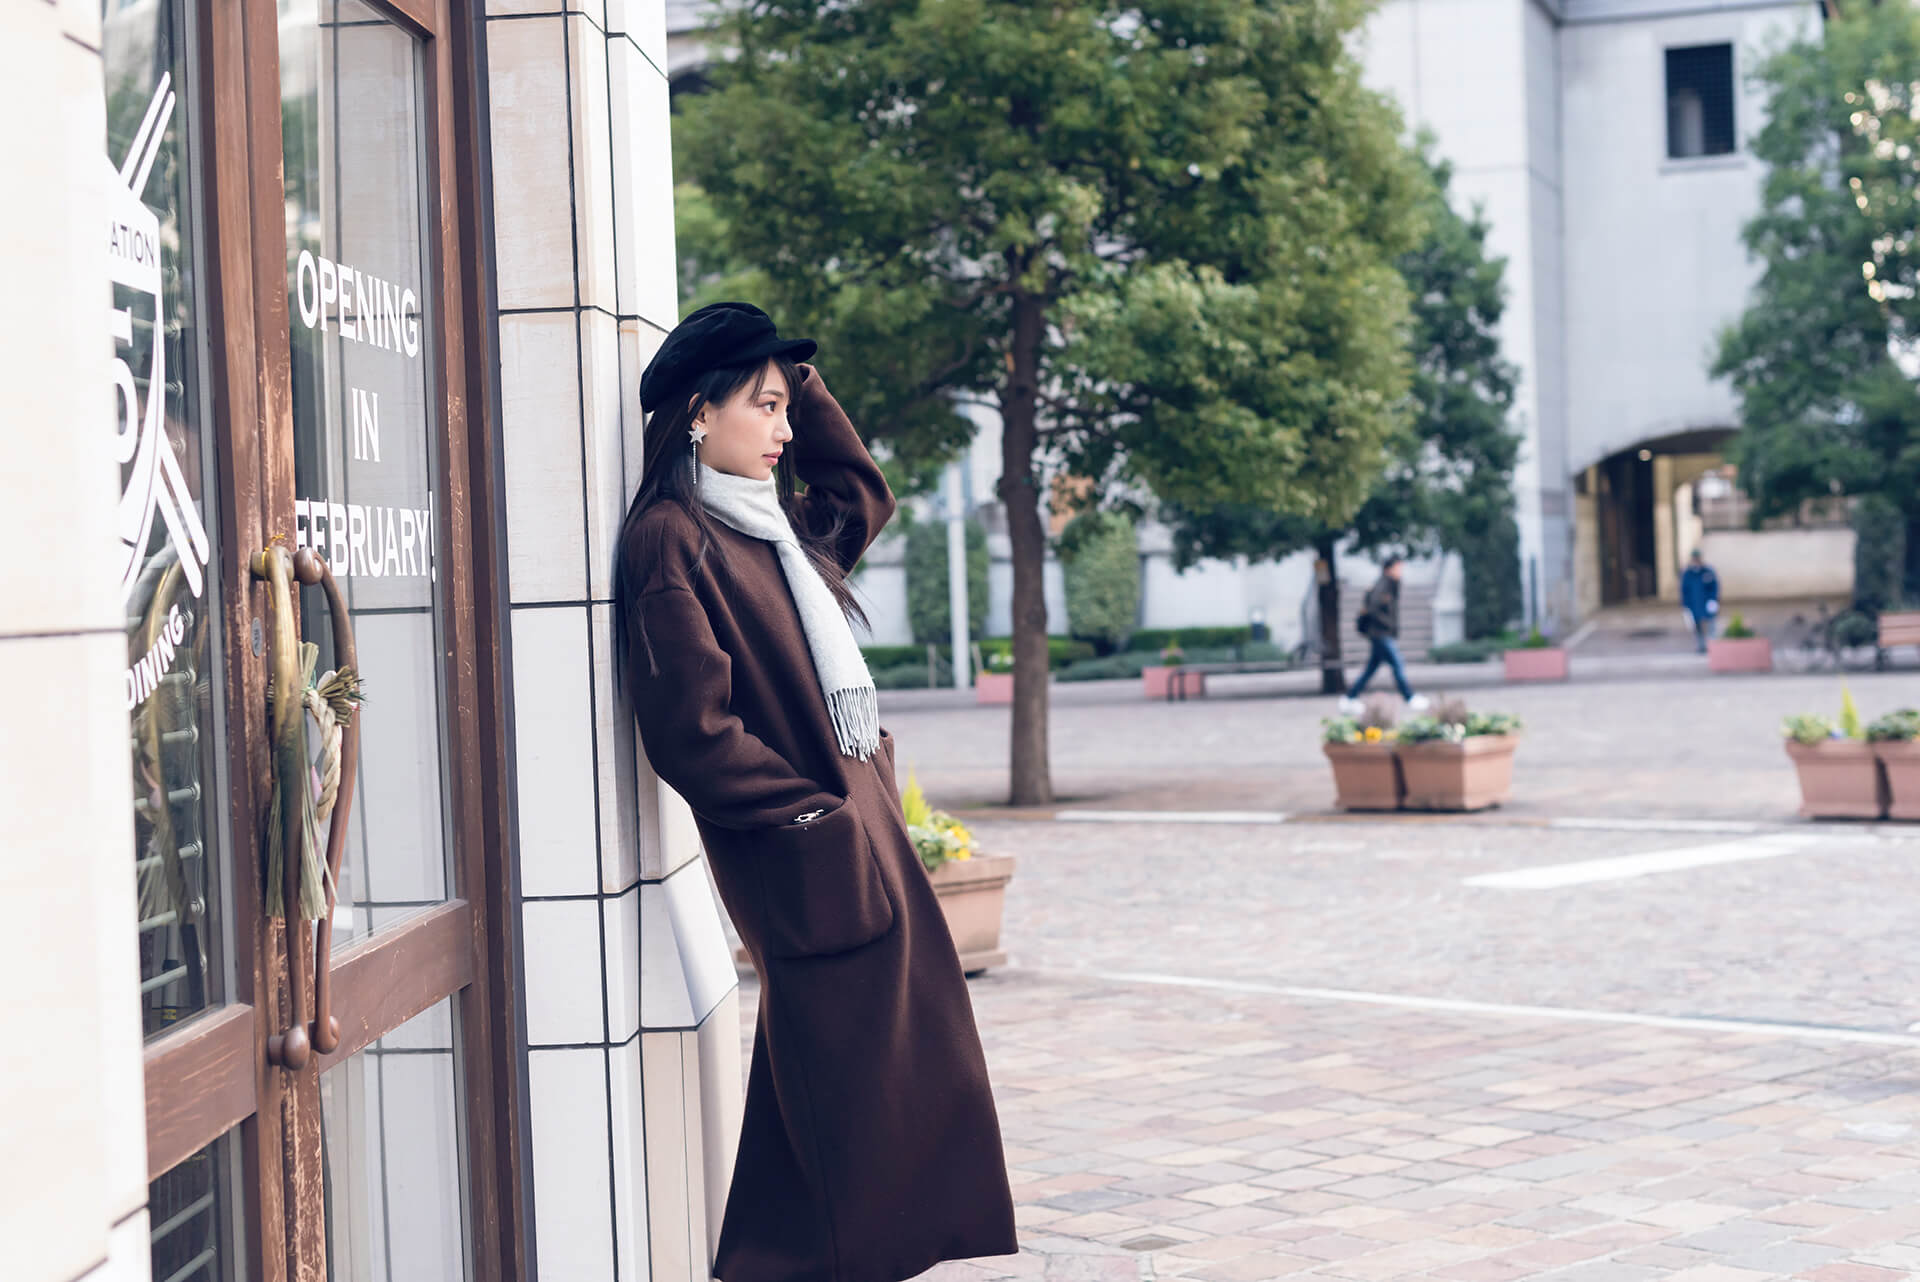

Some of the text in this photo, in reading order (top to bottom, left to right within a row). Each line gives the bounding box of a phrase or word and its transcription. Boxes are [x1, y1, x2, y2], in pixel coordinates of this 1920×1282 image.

[297, 249, 419, 358] OPENING
[352, 387, 381, 462] IN
[294, 490, 437, 583] FEBRUARY!
